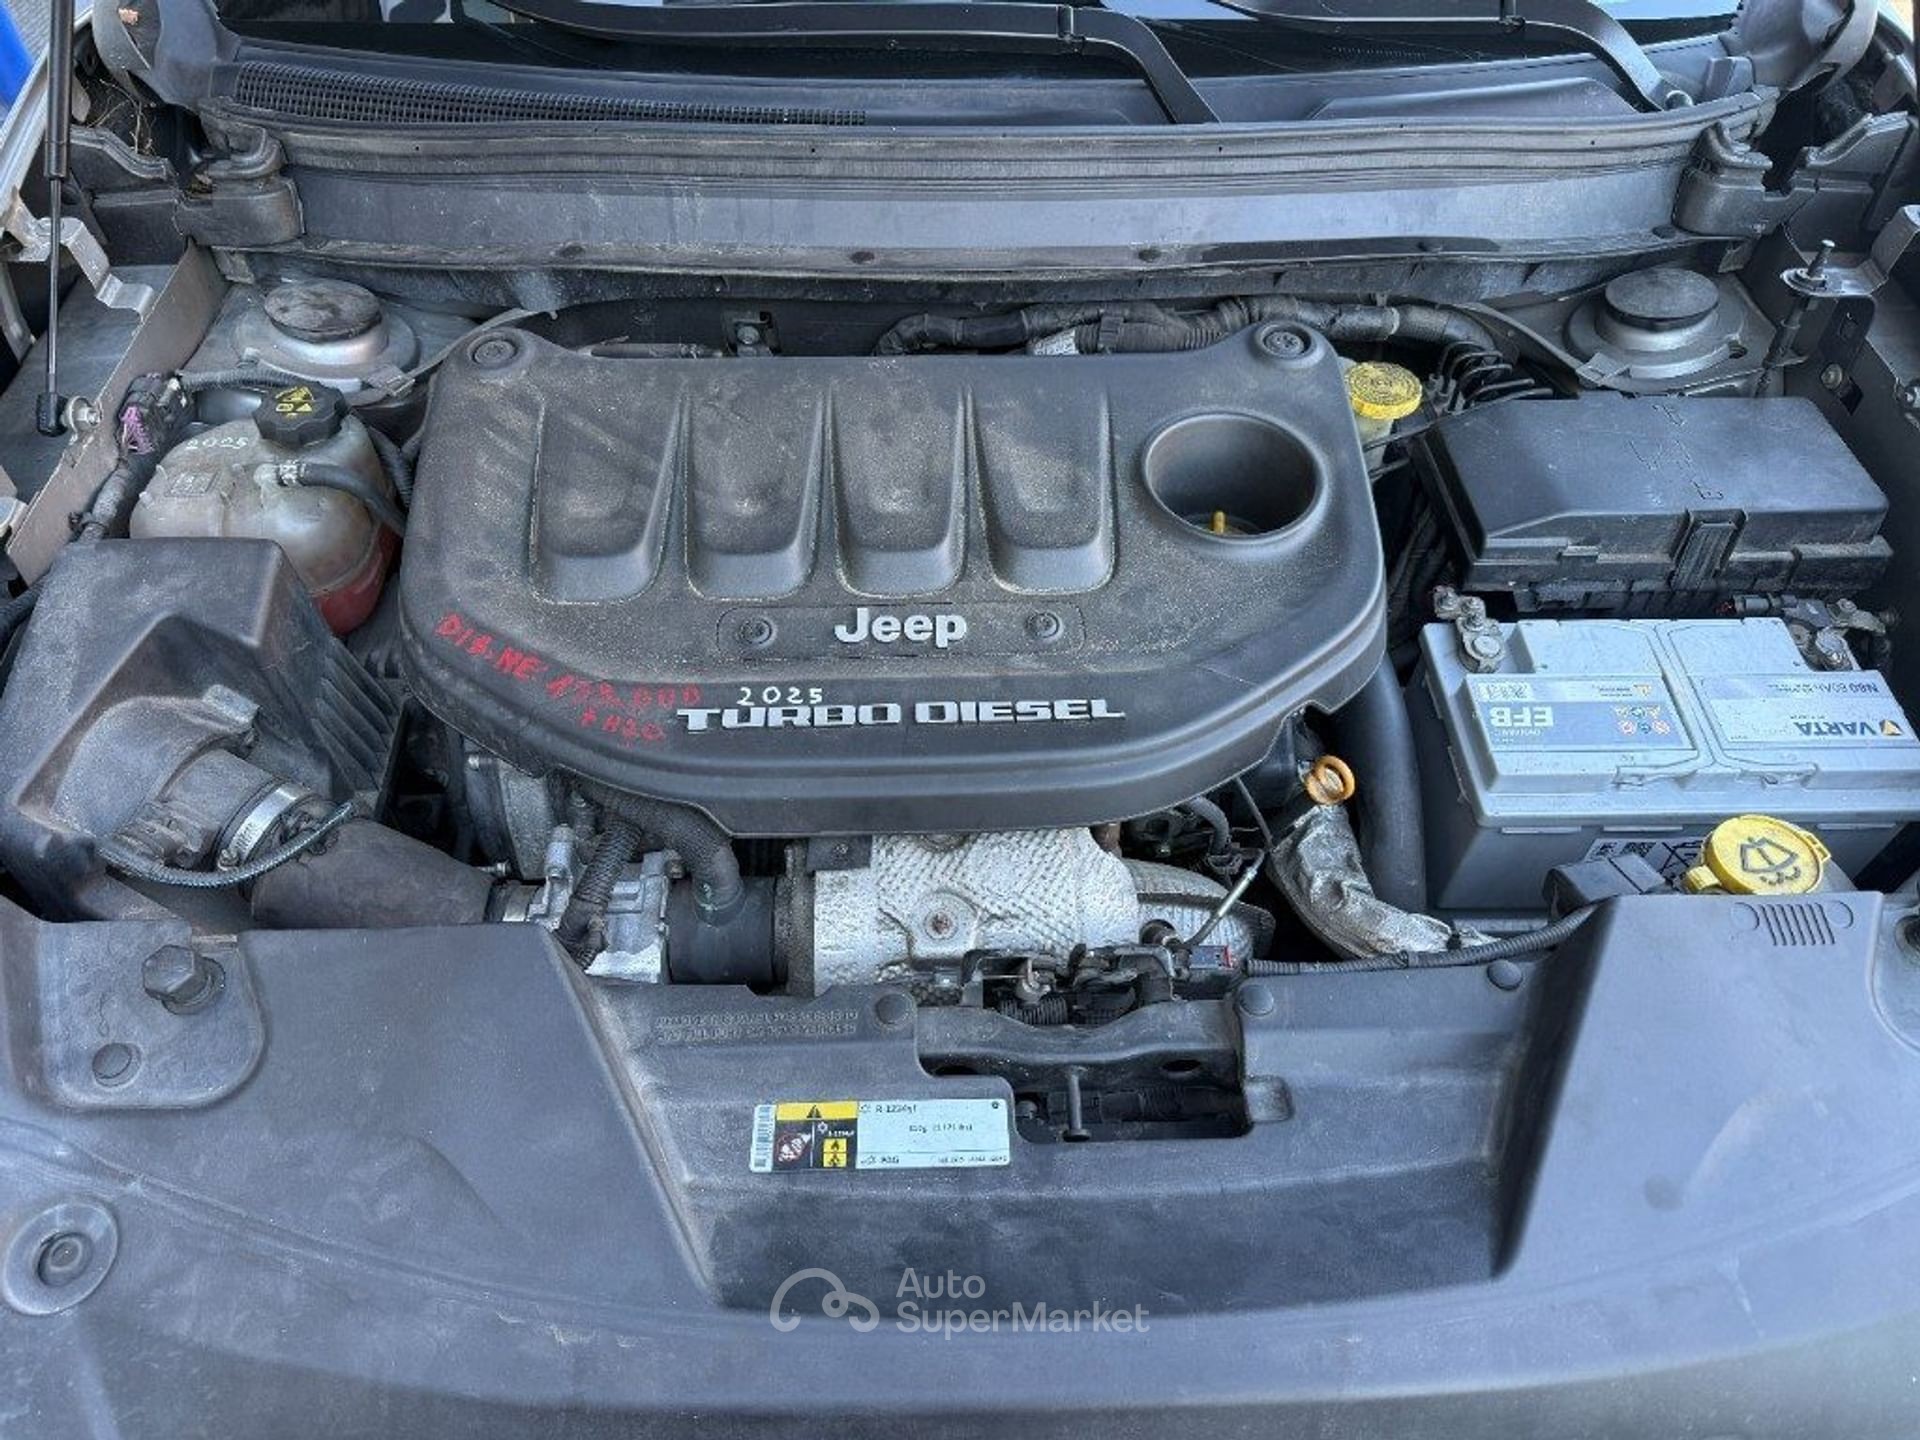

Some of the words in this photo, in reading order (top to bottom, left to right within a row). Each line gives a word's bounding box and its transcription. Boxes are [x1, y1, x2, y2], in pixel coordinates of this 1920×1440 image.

[185, 437, 249, 450] 2025
[833, 607, 968, 649] Jeep
[737, 686, 824, 706] 2025
[677, 701, 901, 733] TURBO
[914, 697, 1126, 725] DIESEL
[1489, 706, 1553, 727] EFB
[1793, 721, 1878, 737] VARTA
